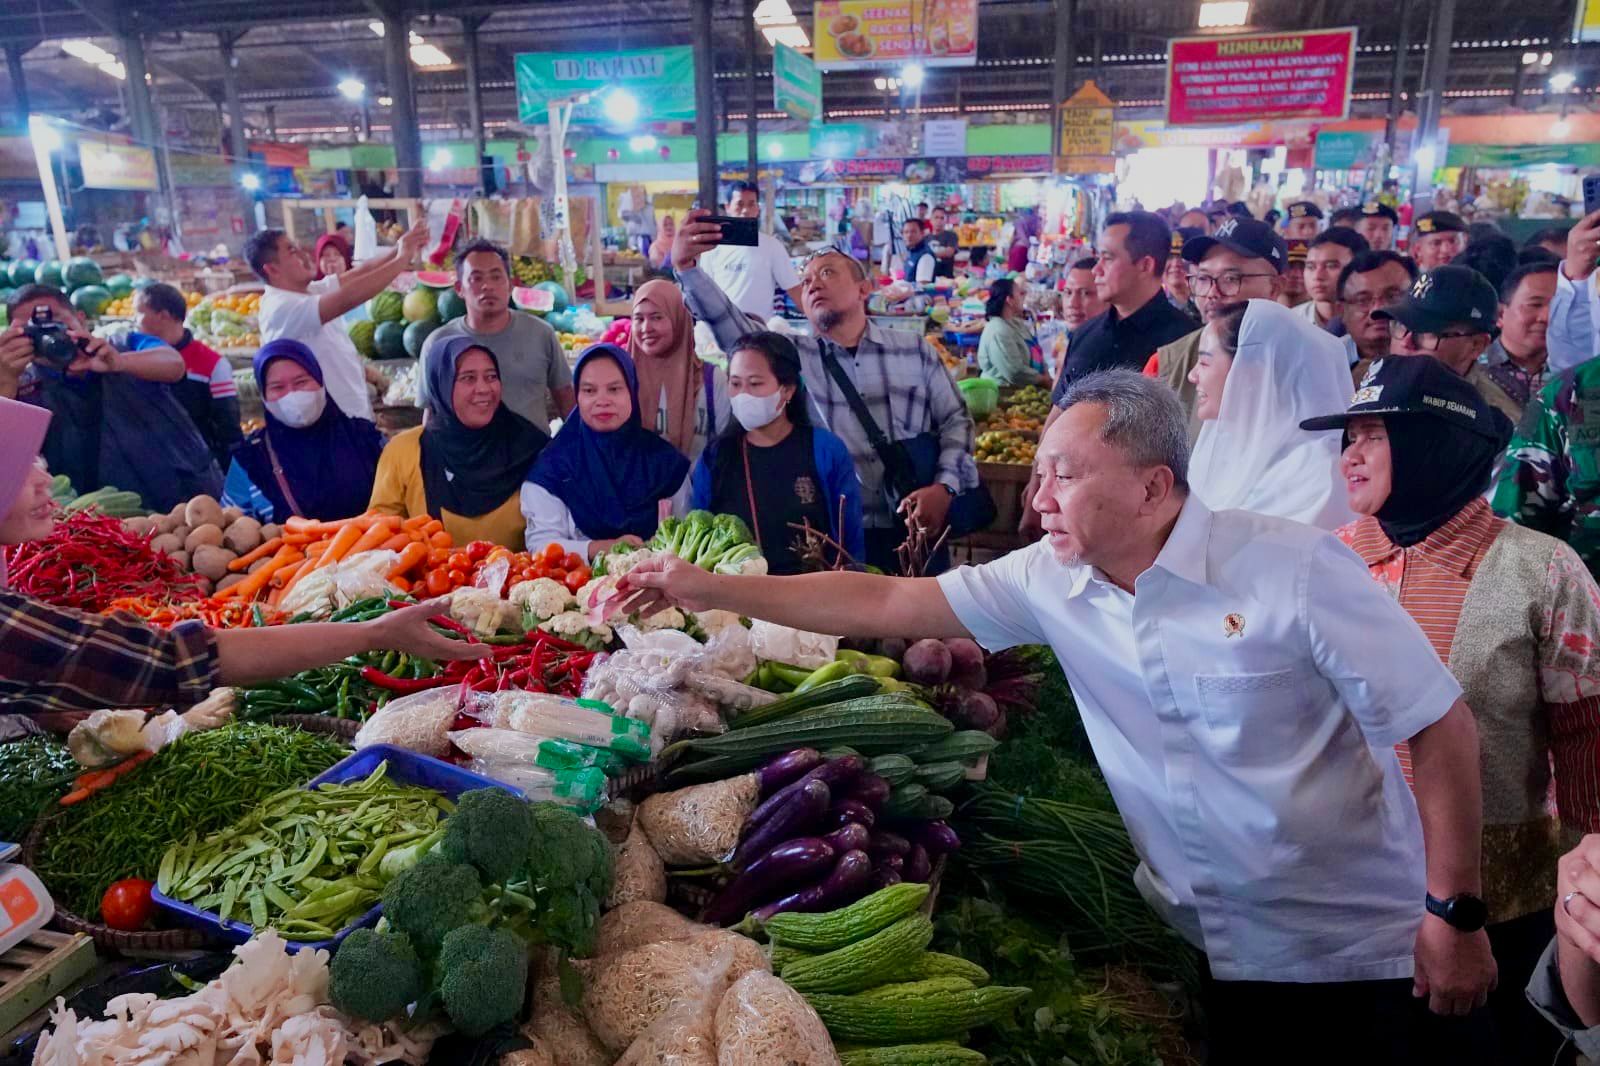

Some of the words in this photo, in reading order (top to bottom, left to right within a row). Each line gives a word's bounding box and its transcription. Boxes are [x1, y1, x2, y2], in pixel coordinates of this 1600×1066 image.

[879, 39, 927, 50] SENDRI
[1217, 38, 1304, 55] HIMBAUAN
[554, 60, 580, 78] UD
[1422, 394, 1446, 408] WABUP
[1446, 401, 1477, 420] SEMARANG
